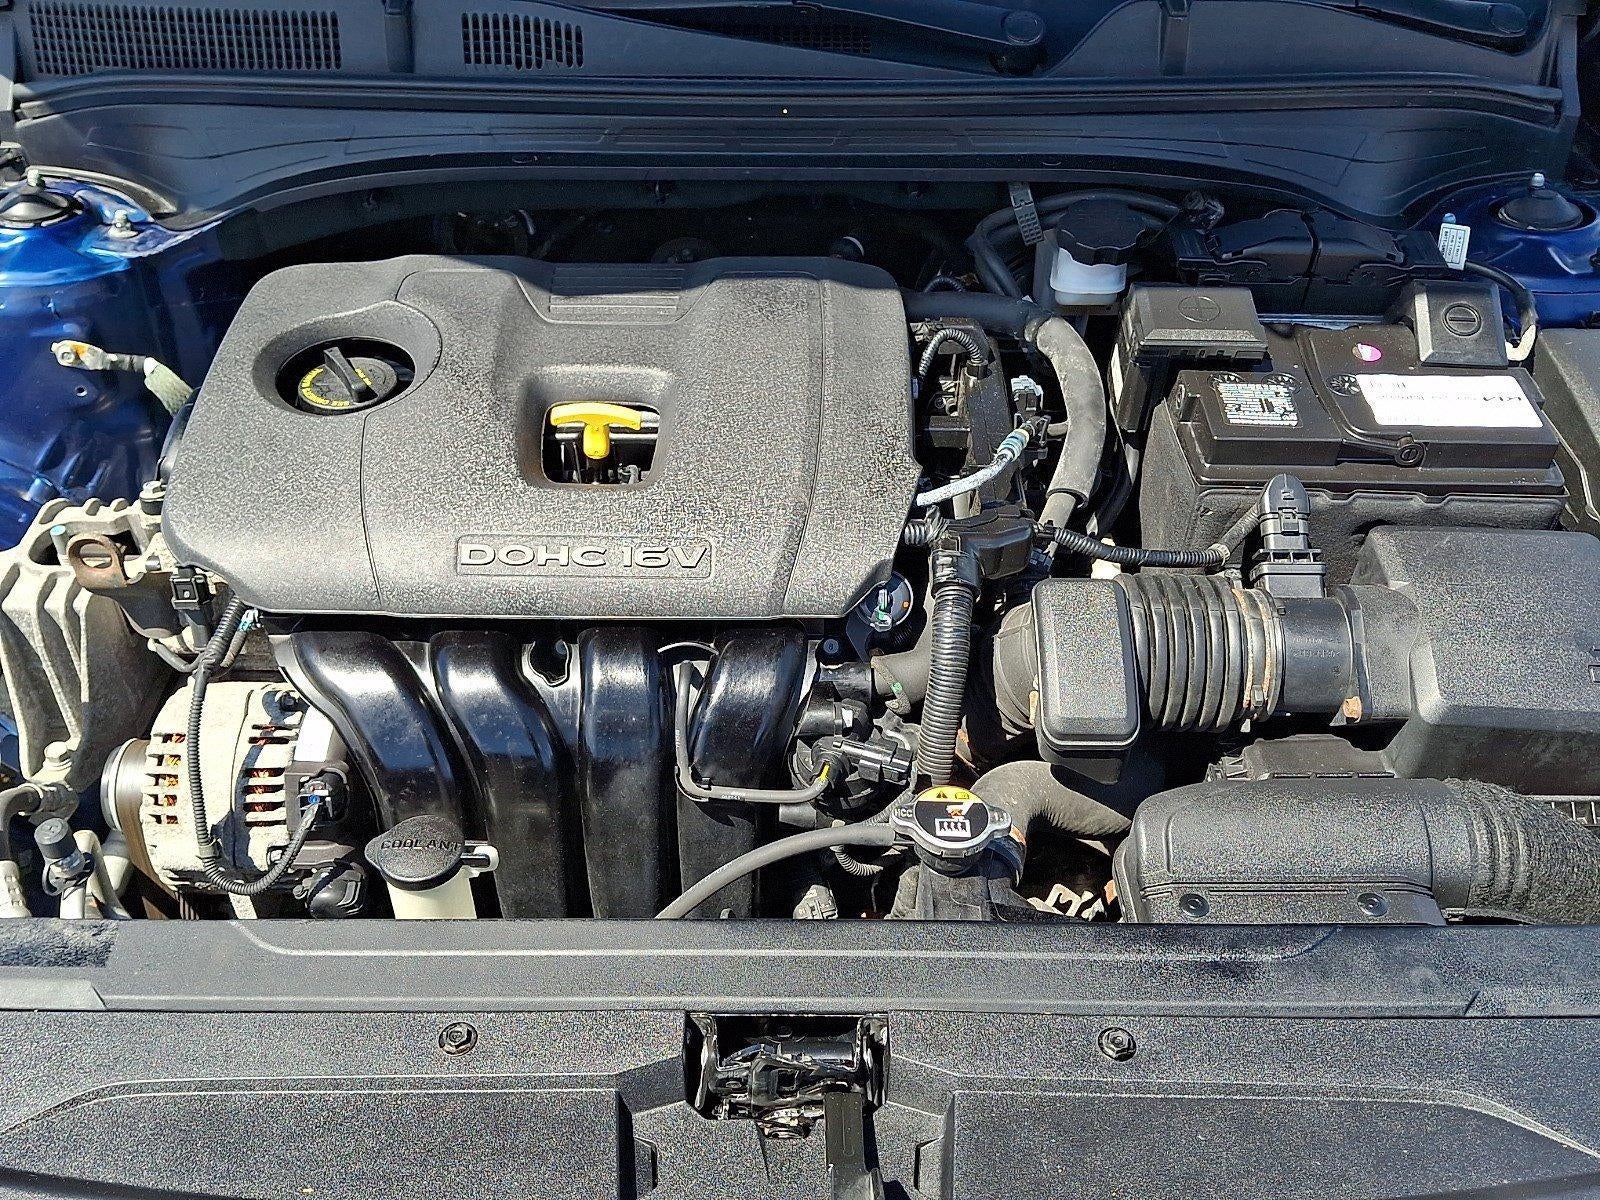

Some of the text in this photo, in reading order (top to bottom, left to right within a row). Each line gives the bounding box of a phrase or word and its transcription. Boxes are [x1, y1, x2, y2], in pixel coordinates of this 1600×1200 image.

[460, 543, 708, 569] DOHC 16V
[894, 808, 914, 818] HCC
[380, 838, 461, 851] COOLANT
